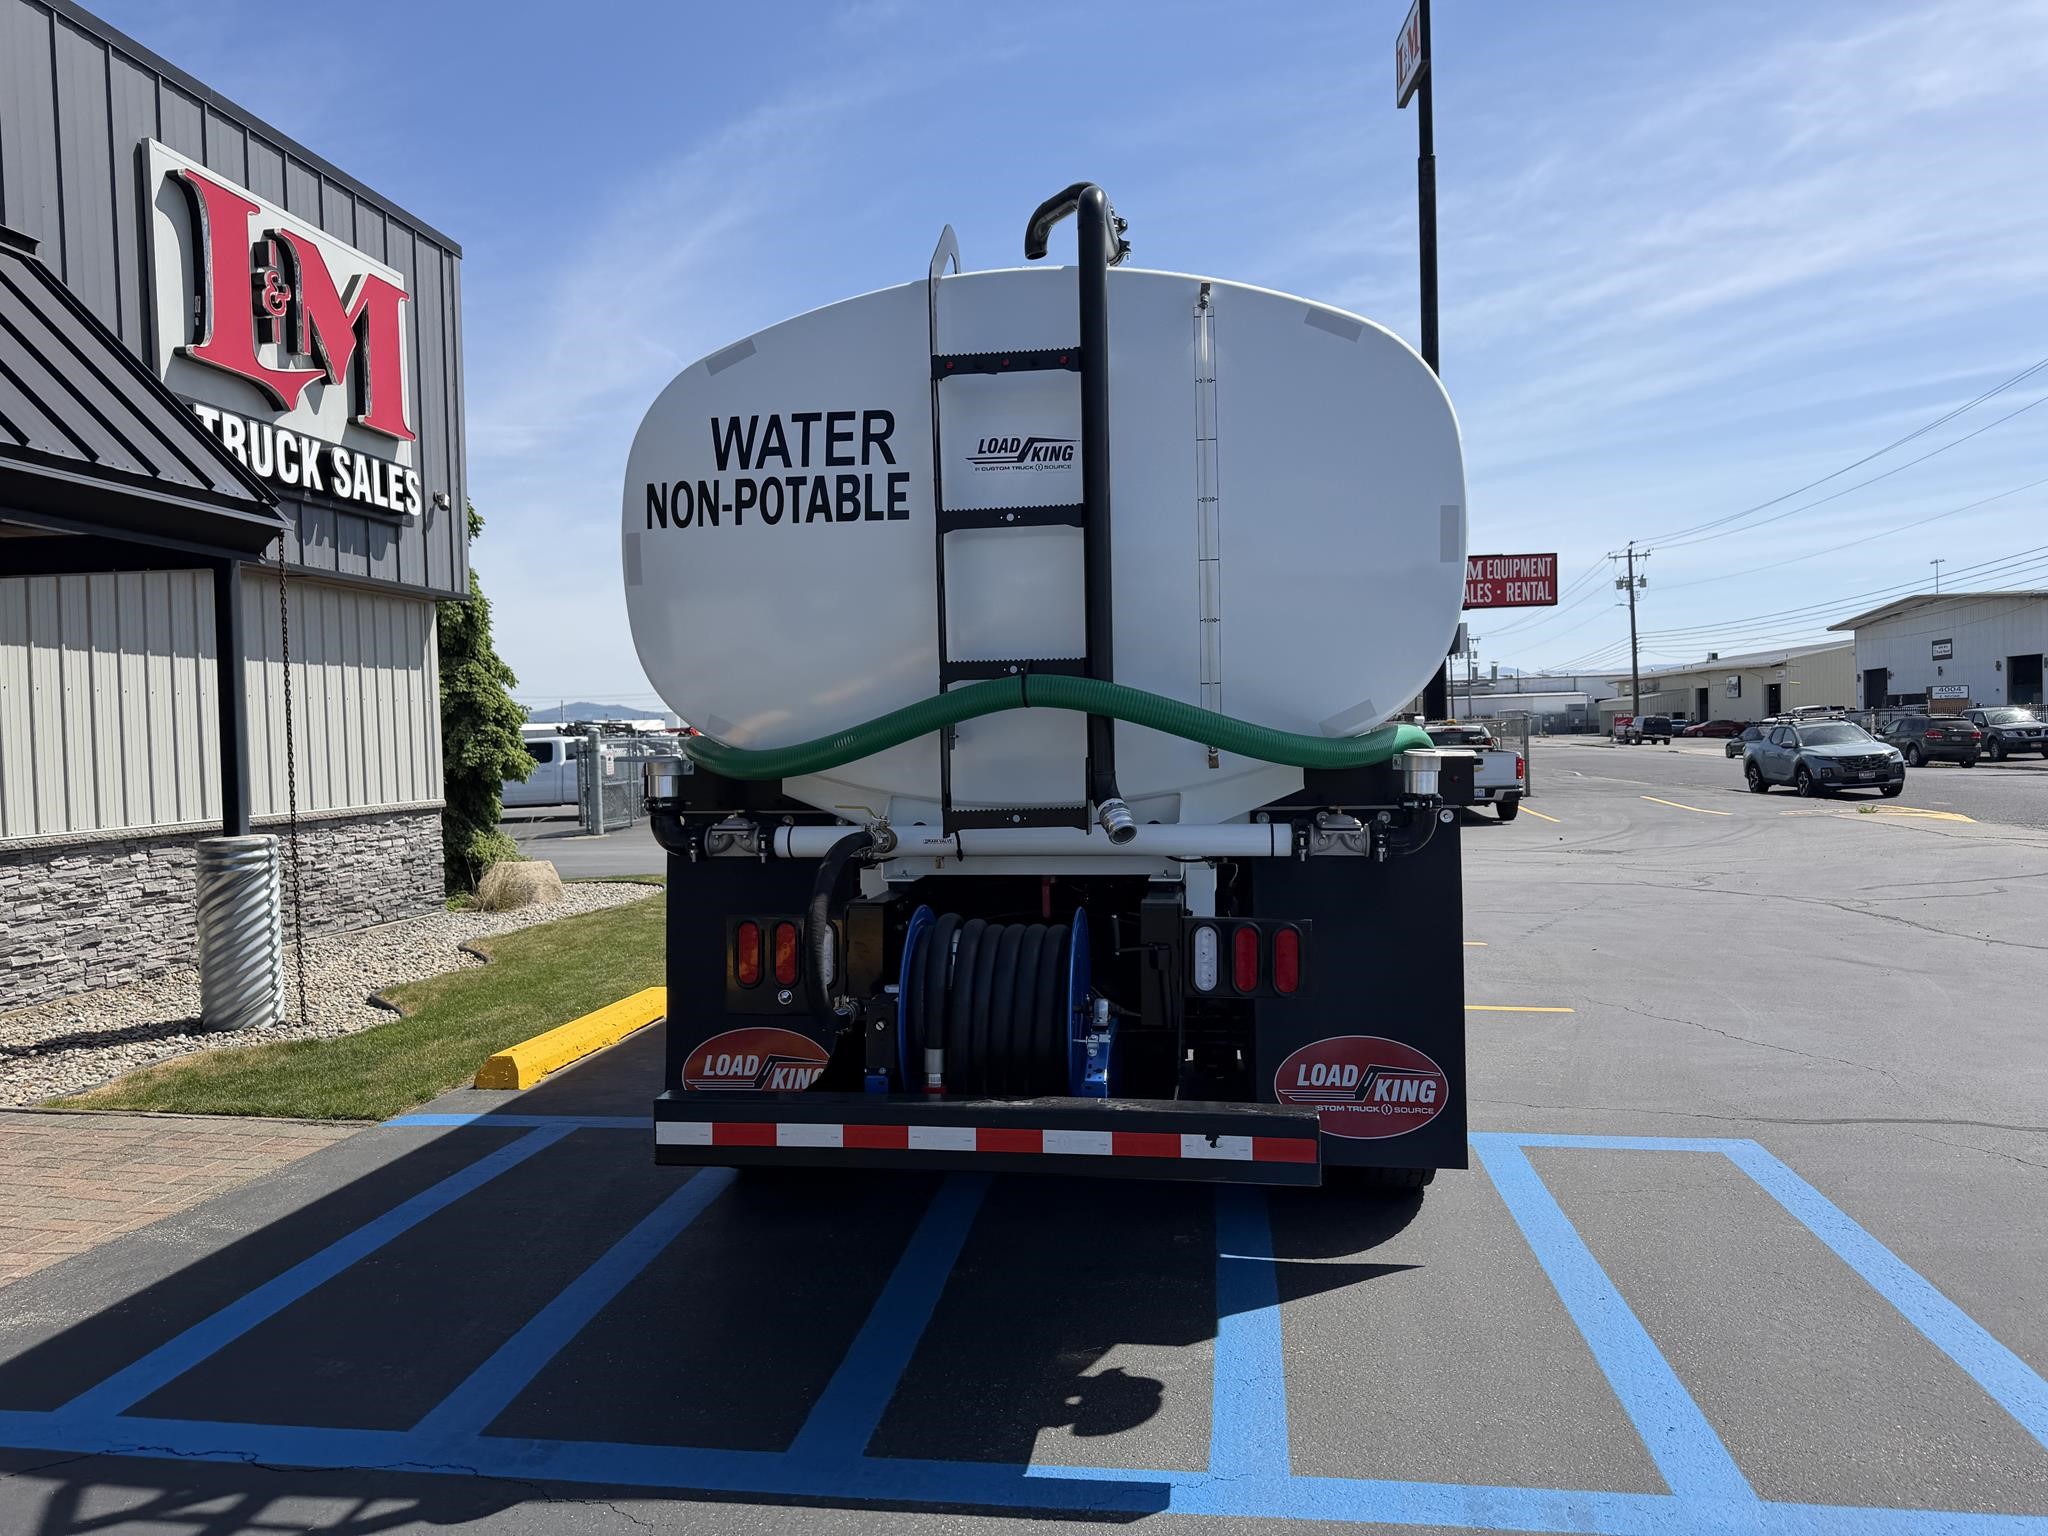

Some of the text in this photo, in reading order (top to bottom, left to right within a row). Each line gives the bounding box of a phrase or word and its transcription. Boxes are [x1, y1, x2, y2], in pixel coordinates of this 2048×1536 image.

[710, 409, 897, 471] WATER
[977, 437, 1074, 462] LOAD KING
[193, 402, 421, 516] TRUCK SALES
[646, 471, 910, 530] NON-POTABLE
[1487, 557, 1552, 580] EQUIPMENT
[1506, 581, 1552, 602] RENTAL
[703, 1054, 760, 1076] LOAD
[1297, 1063, 1359, 1087] LOAD
[1374, 1078, 1437, 1104] KING
[1346, 1105, 1380, 1113] TRUCK
[1394, 1106, 1434, 1115] SOURCE
